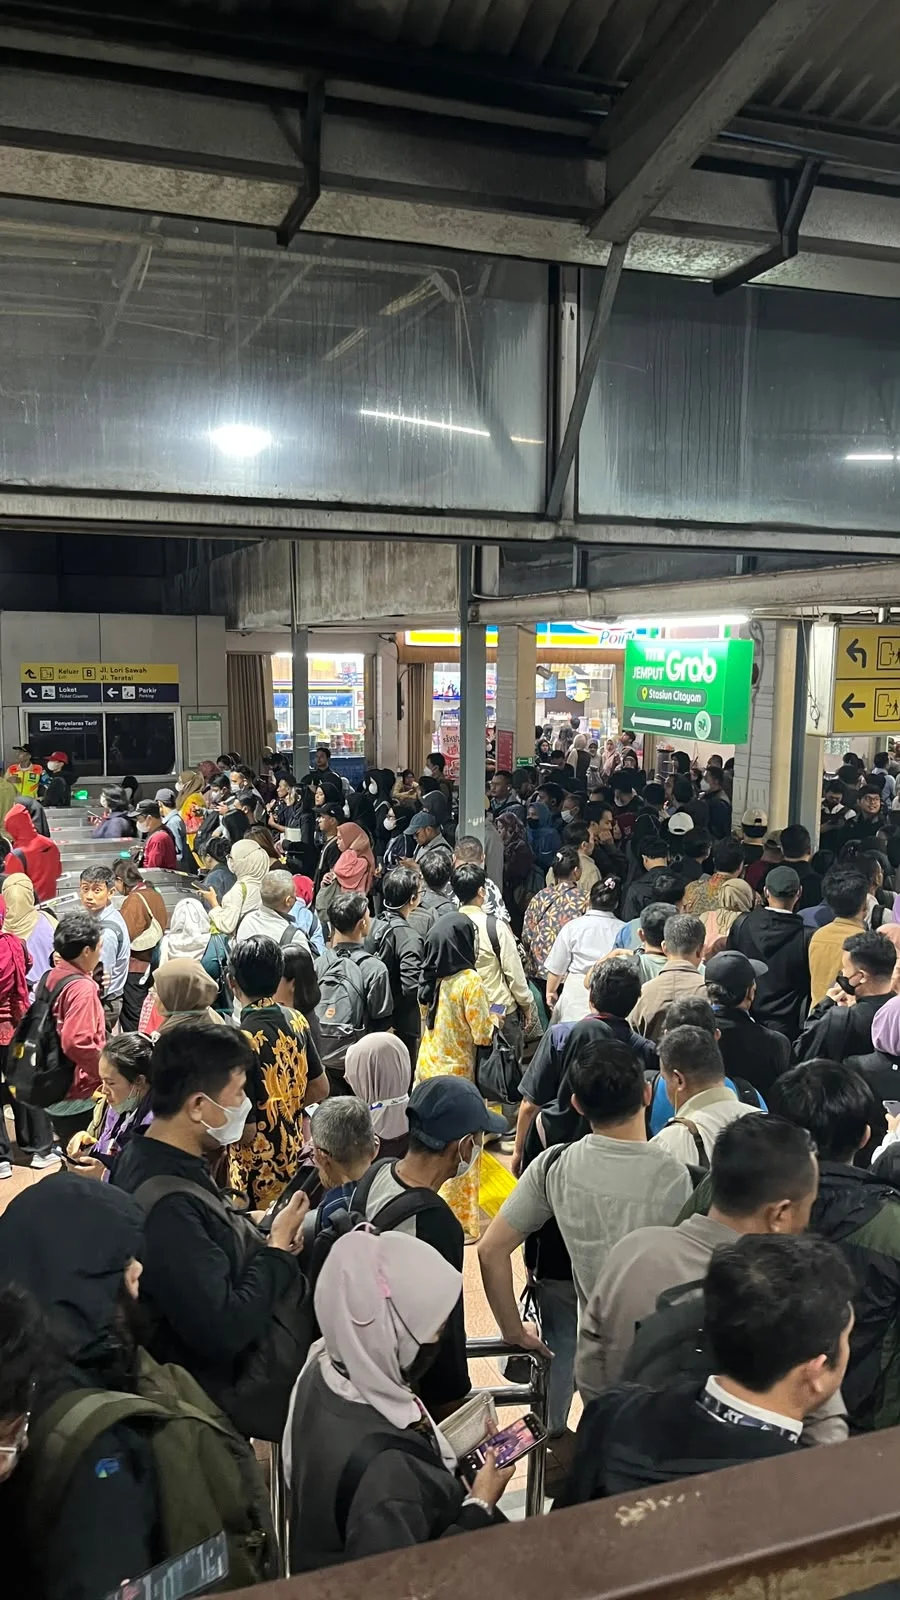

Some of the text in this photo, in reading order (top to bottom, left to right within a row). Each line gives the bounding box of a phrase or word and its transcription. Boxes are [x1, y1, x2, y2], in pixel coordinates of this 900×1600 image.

[86, 669, 93, 677] B
[632, 648, 717, 684] JEMPUT Grab
[648, 688, 702, 704] Stasiun Citayam
[671, 717, 692, 732] 50 m
